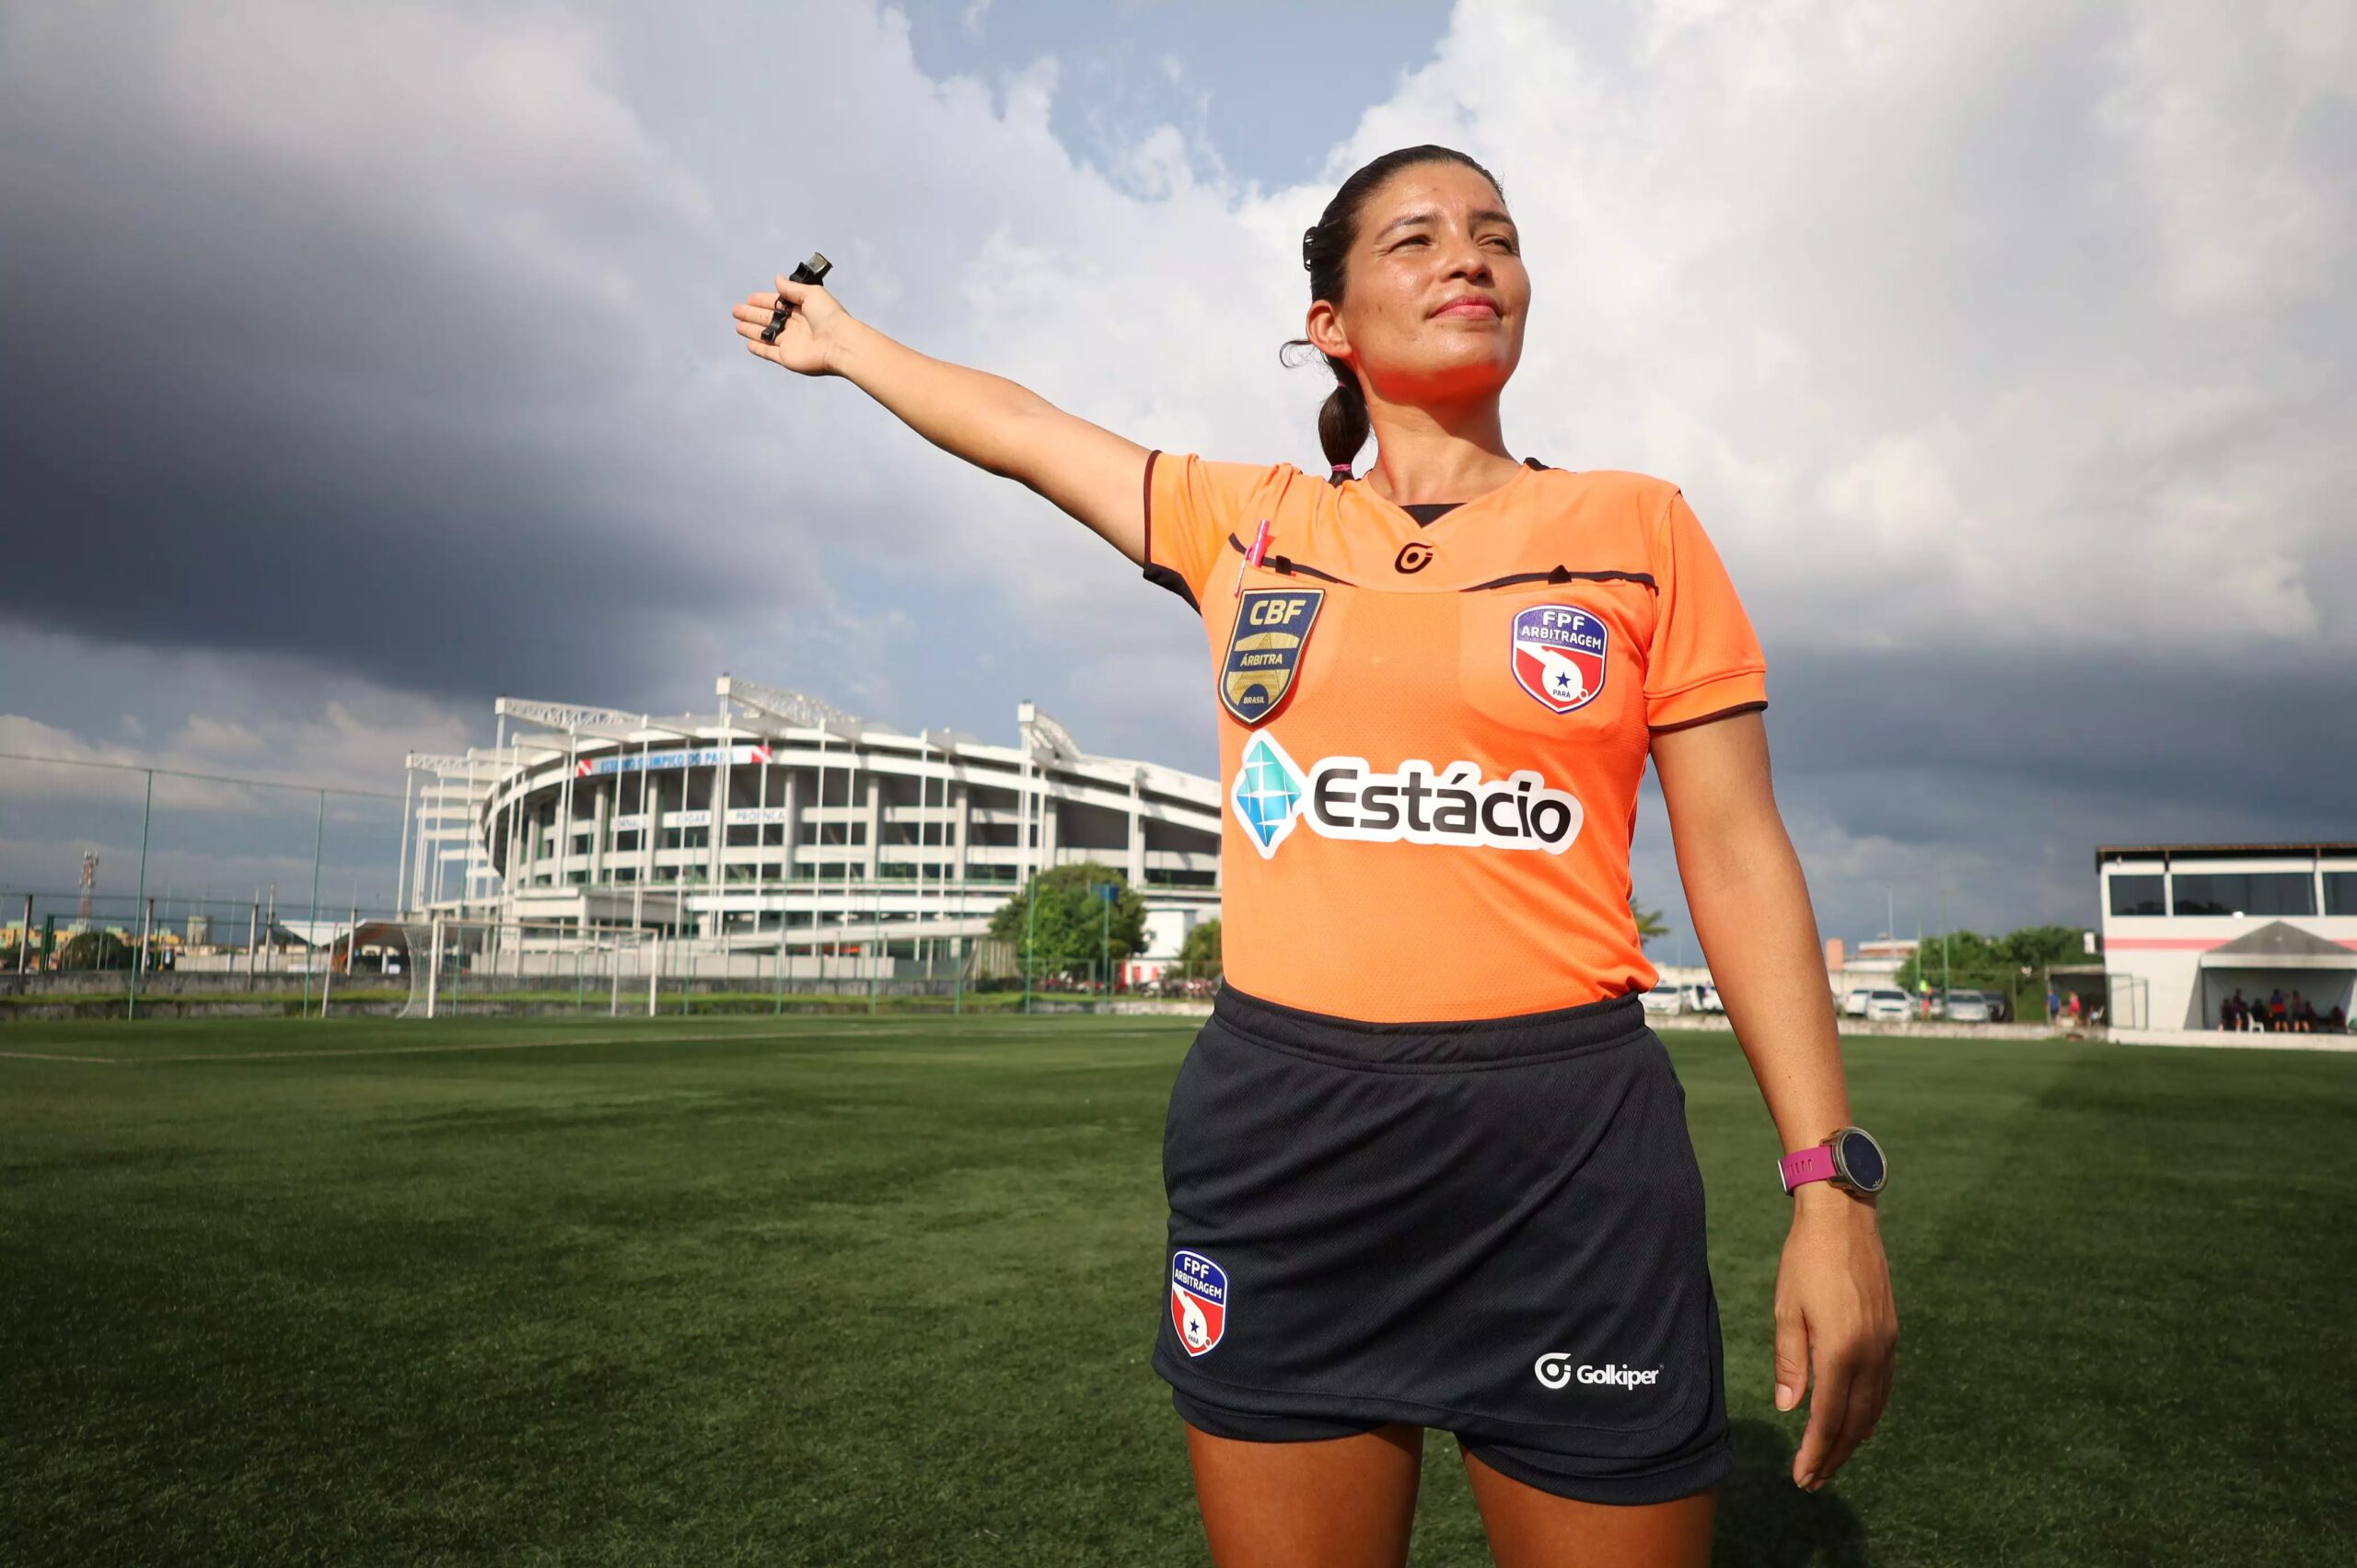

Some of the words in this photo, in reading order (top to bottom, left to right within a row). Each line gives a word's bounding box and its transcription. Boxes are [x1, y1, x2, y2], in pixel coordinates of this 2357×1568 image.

[1249, 599, 1306, 625] CBF
[1542, 610, 1585, 631] FPF
[1521, 626, 1601, 650] ARBITRAGEM
[1240, 653, 1283, 667] ÁRBITRA
[1243, 696, 1265, 704] BRASIL
[601, 756, 634, 773] ESTDIO
[638, 751, 683, 770] OÍMPICO
[676, 813, 706, 825] EGAR
[737, 810, 784, 822] PRONÇA
[1313, 768, 1572, 844] Estácio
[1184, 1256, 1210, 1279] FPF
[1174, 1268, 1222, 1299] ARBITRAGEM
[1576, 1364, 1659, 1390] Golkiper
